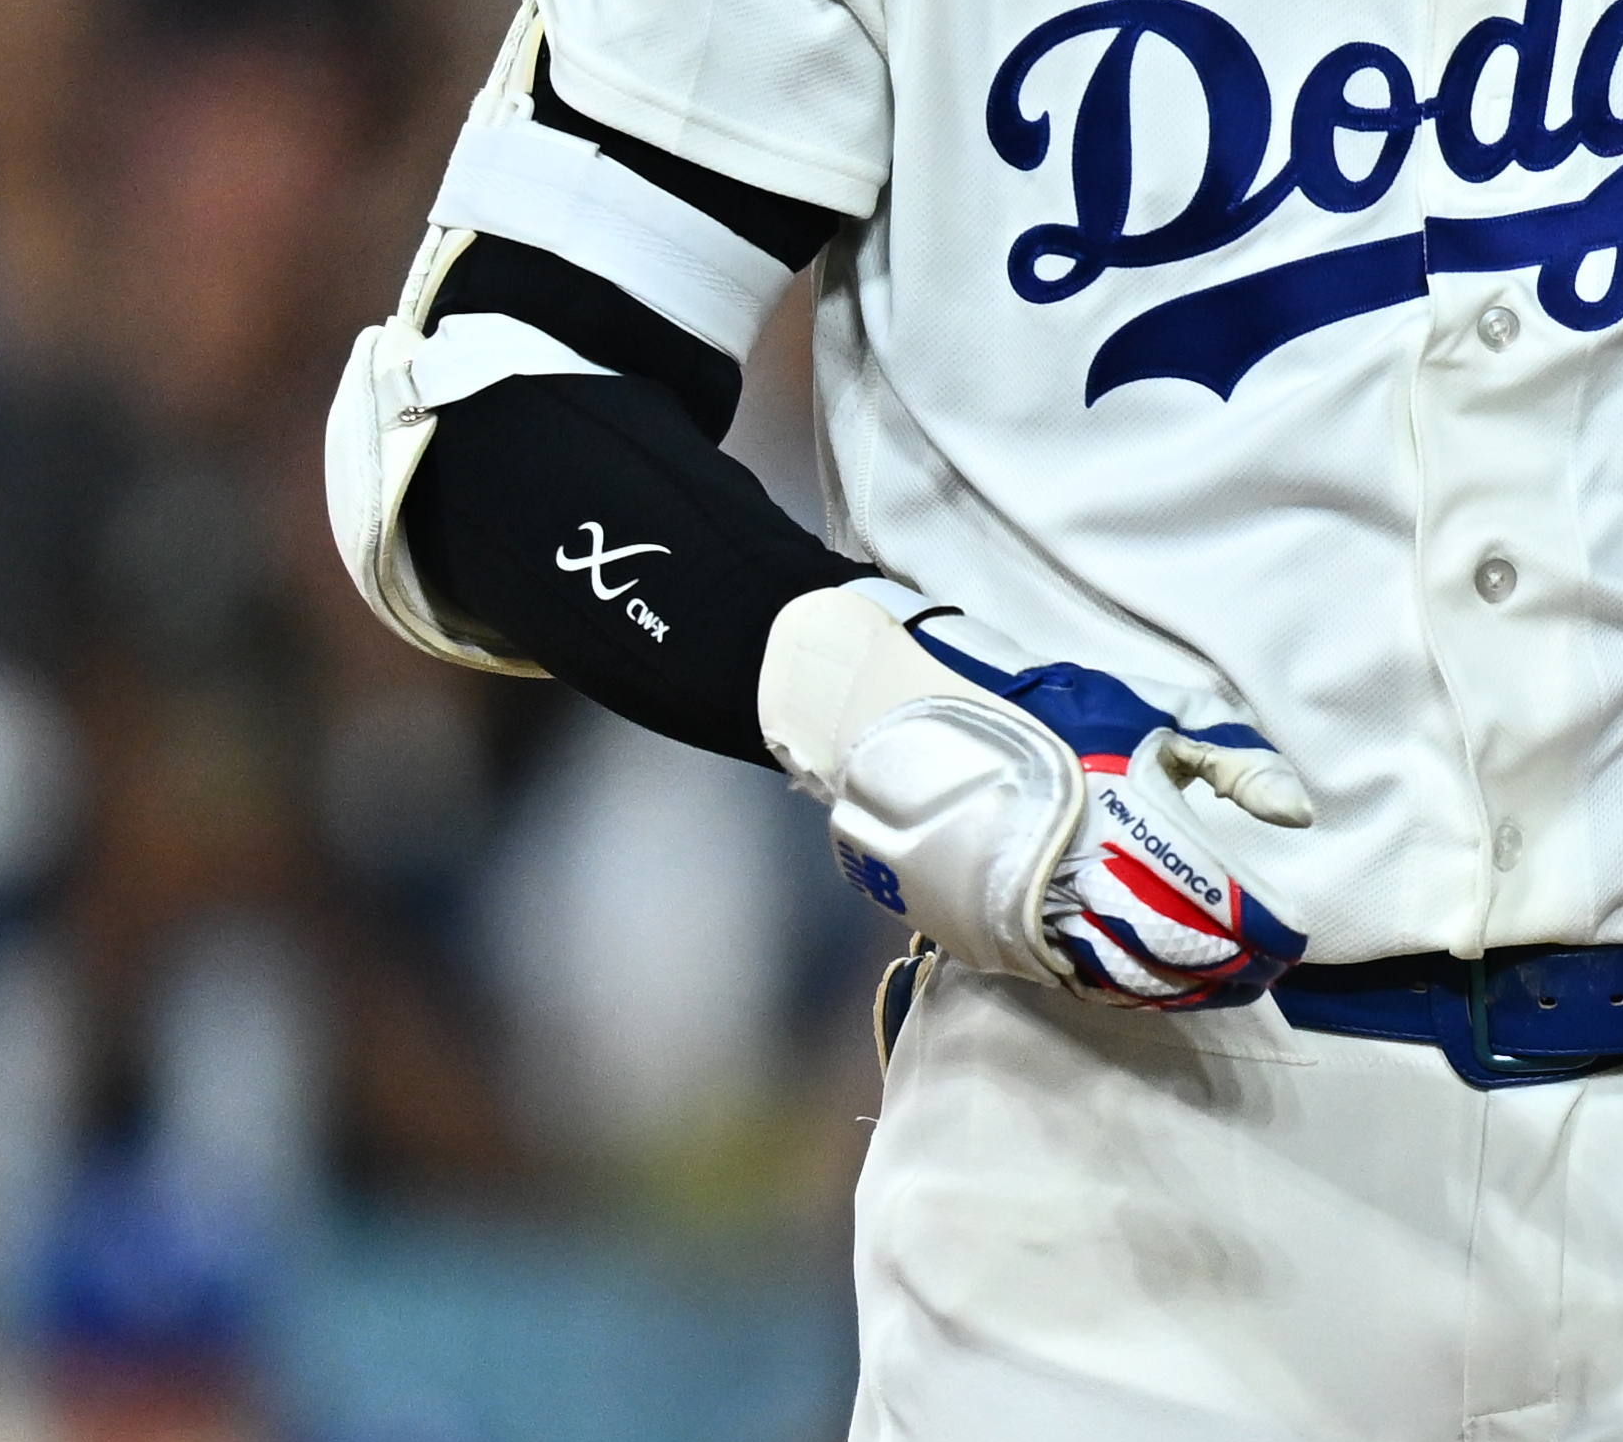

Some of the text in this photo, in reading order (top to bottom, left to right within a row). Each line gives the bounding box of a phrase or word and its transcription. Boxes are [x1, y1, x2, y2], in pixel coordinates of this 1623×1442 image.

[626, 597, 670, 644] CW-X
[1098, 788, 1223, 906] new balance
